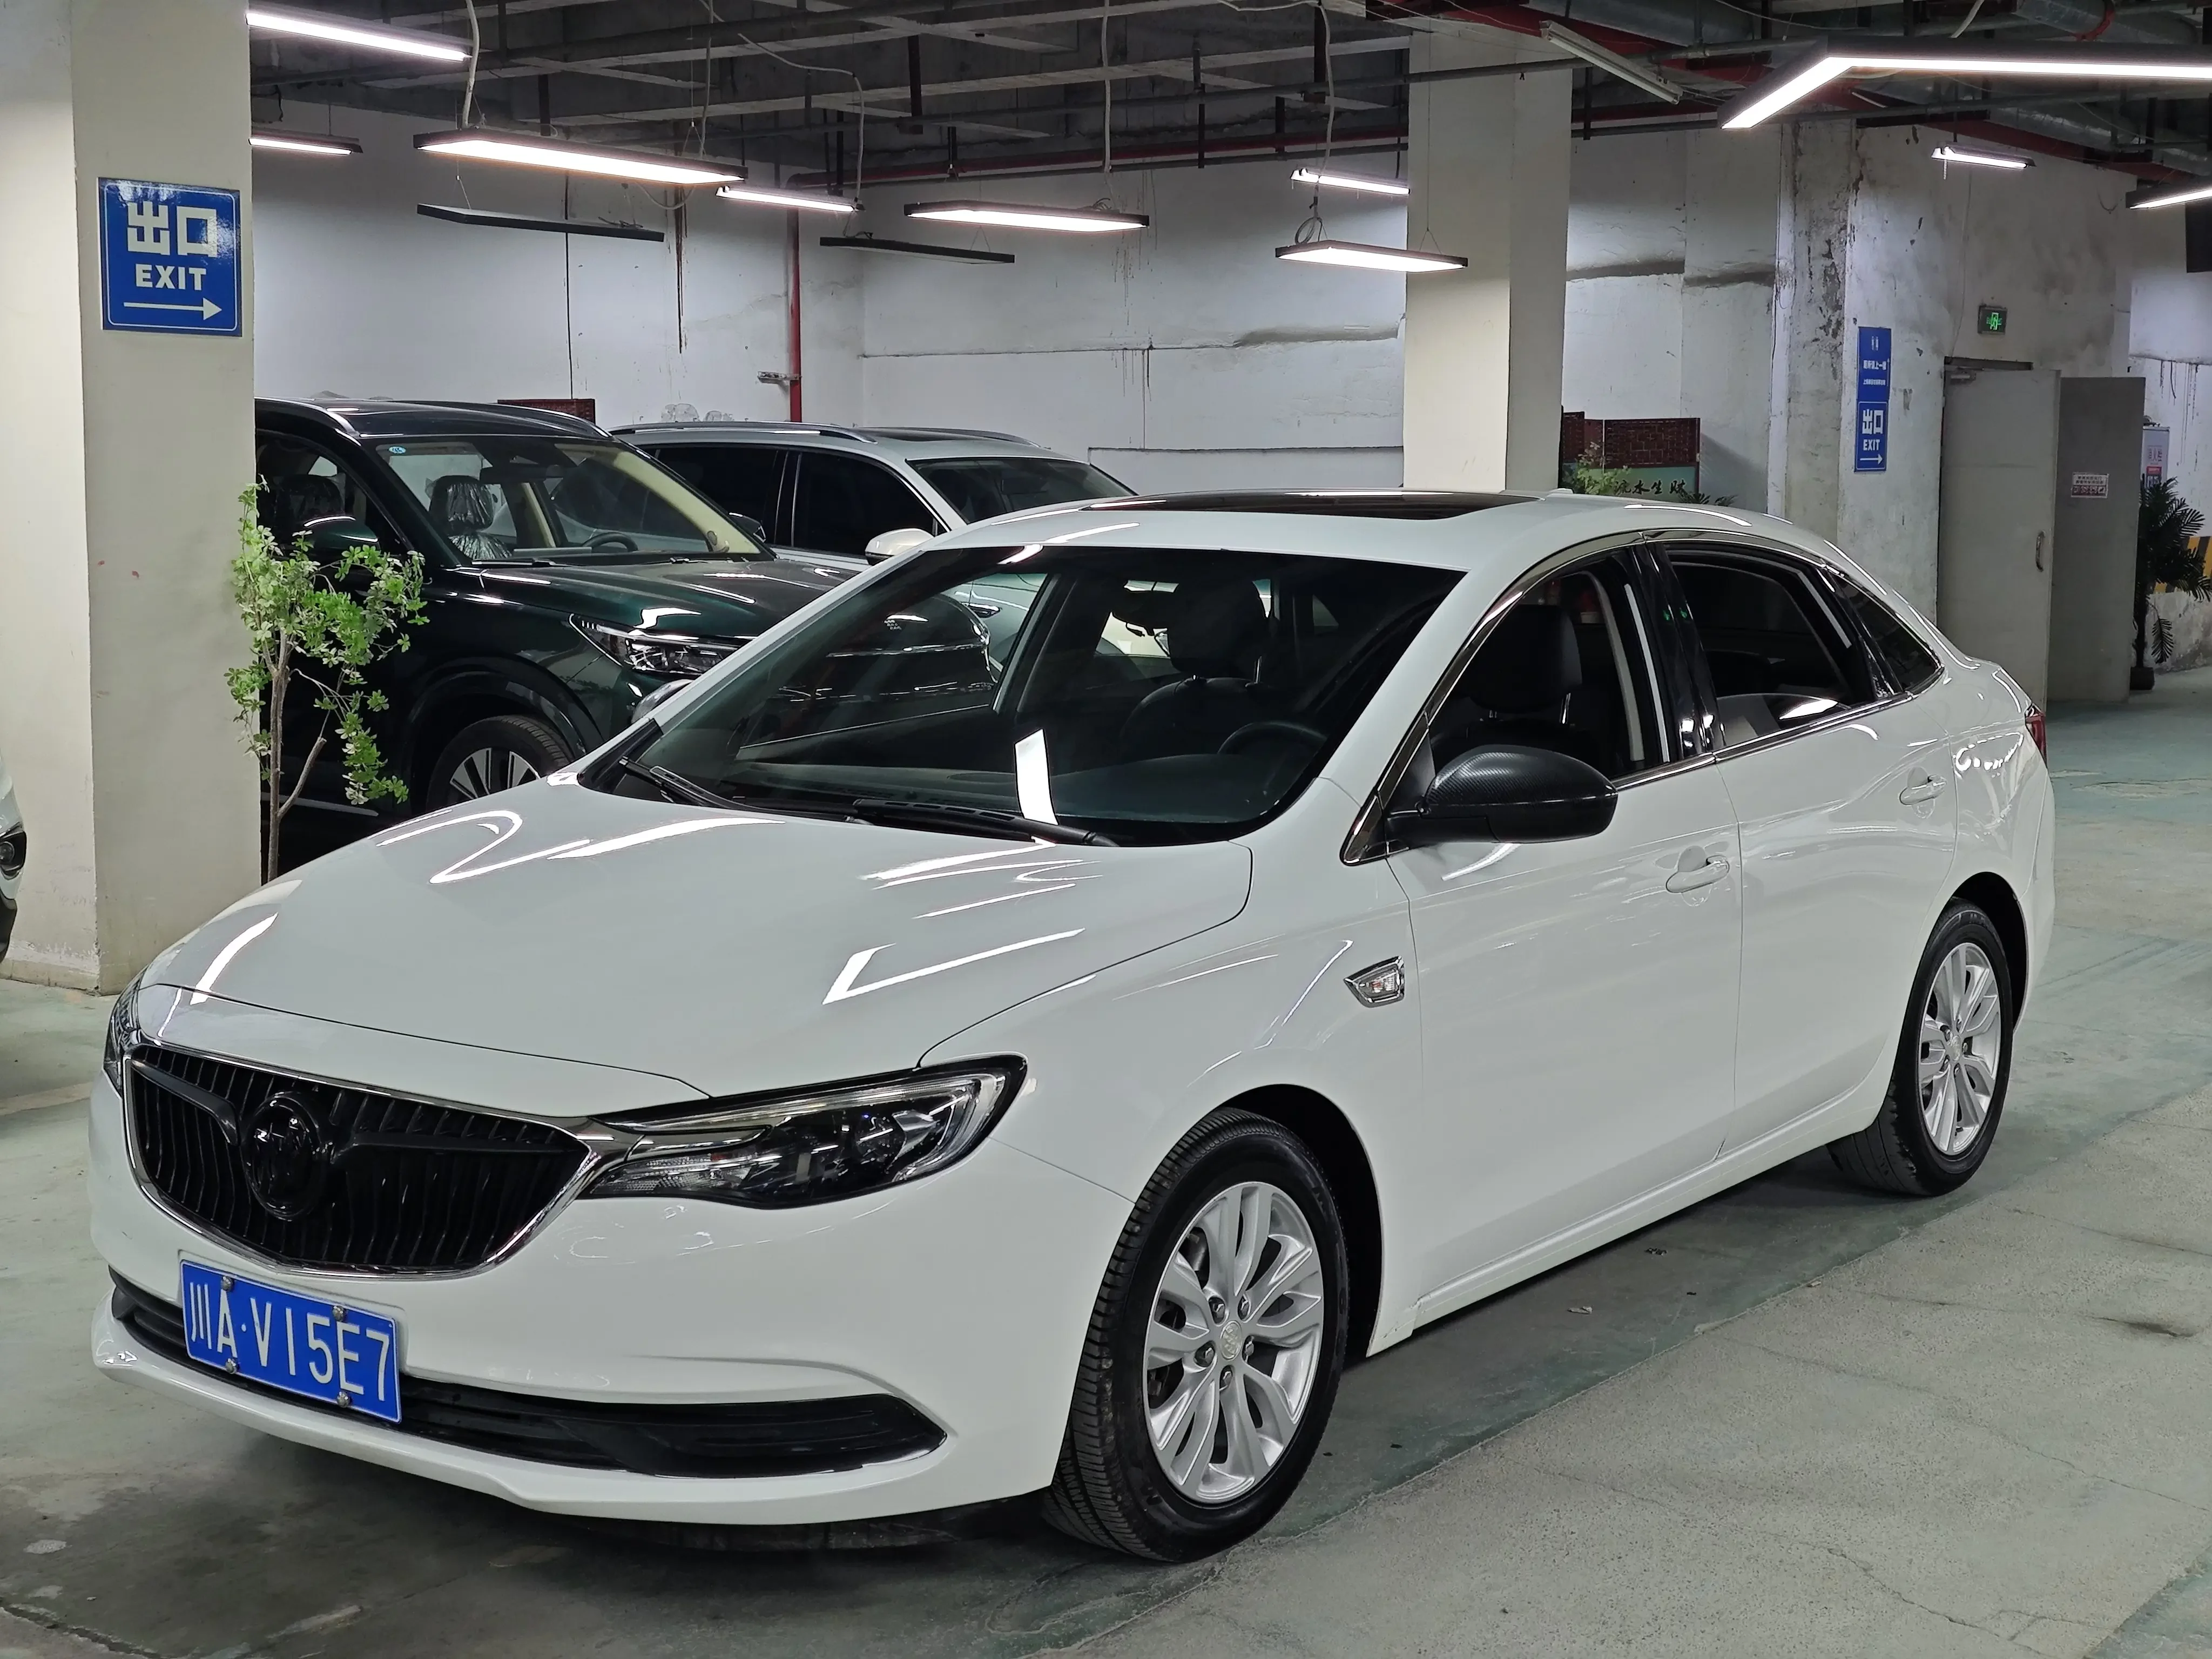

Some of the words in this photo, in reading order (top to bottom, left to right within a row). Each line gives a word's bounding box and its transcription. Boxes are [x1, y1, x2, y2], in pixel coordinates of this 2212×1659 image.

[127, 200, 218, 257] 出口
[136, 264, 207, 290] EXIT
[1862, 409, 1884, 434] 出口
[1863, 439, 1880, 451] EXIT
